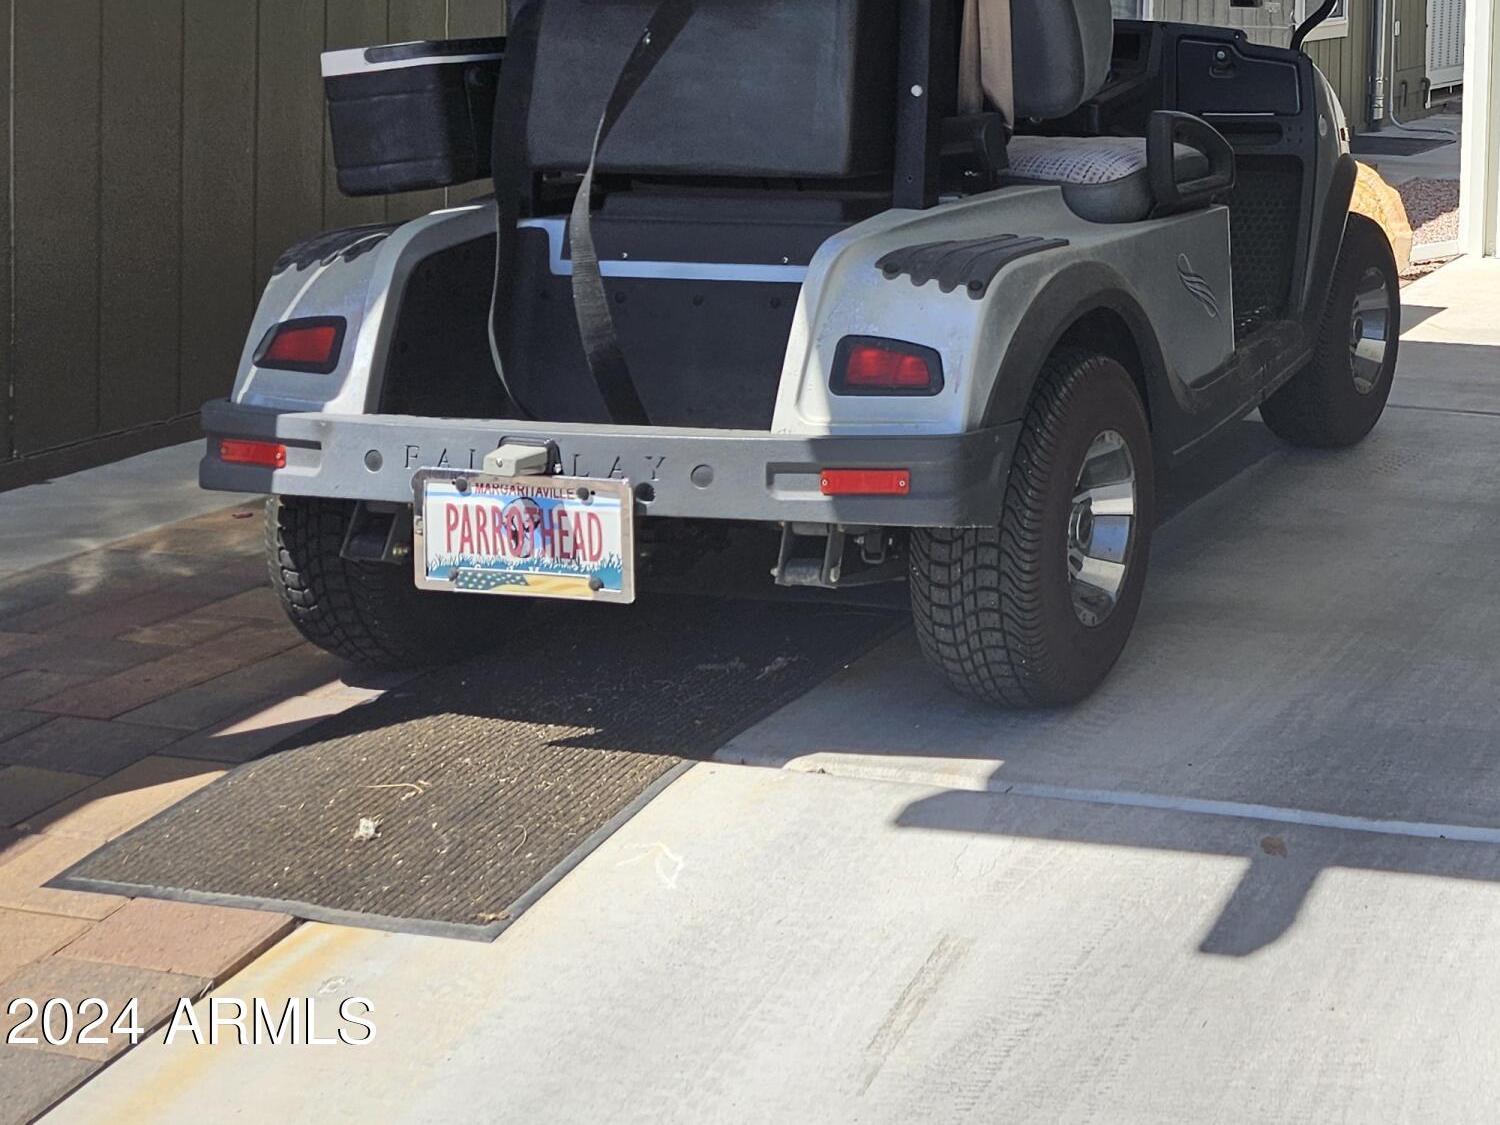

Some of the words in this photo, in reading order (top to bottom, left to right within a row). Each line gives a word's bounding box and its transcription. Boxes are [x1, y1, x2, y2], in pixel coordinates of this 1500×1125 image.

[404, 443, 666, 482] FAILAY
[474, 481, 576, 501] MARGARITAVILLE
[445, 501, 604, 563] PARROTHEAD
